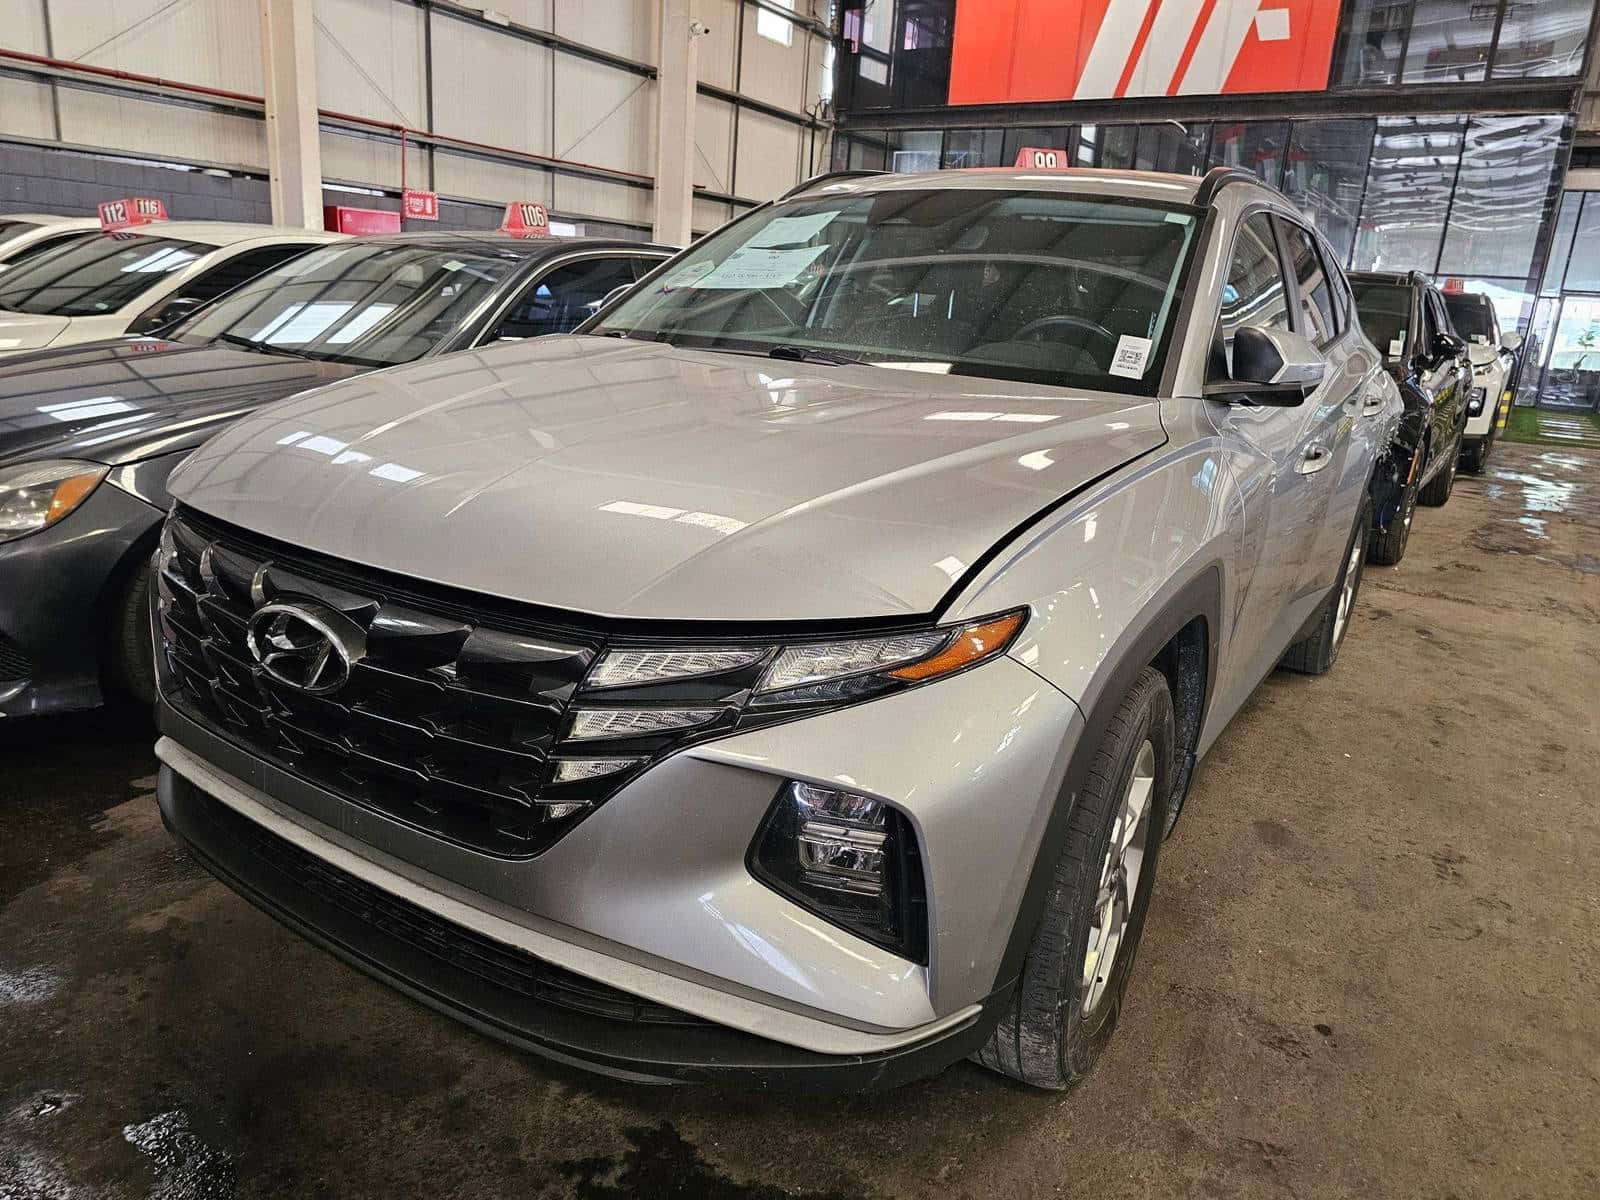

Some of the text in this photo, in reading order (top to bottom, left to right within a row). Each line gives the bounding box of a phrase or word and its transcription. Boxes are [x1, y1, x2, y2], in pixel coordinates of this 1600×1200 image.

[104, 203, 126, 225] 112
[139, 200, 158, 214] 116
[522, 204, 545, 226] 106
